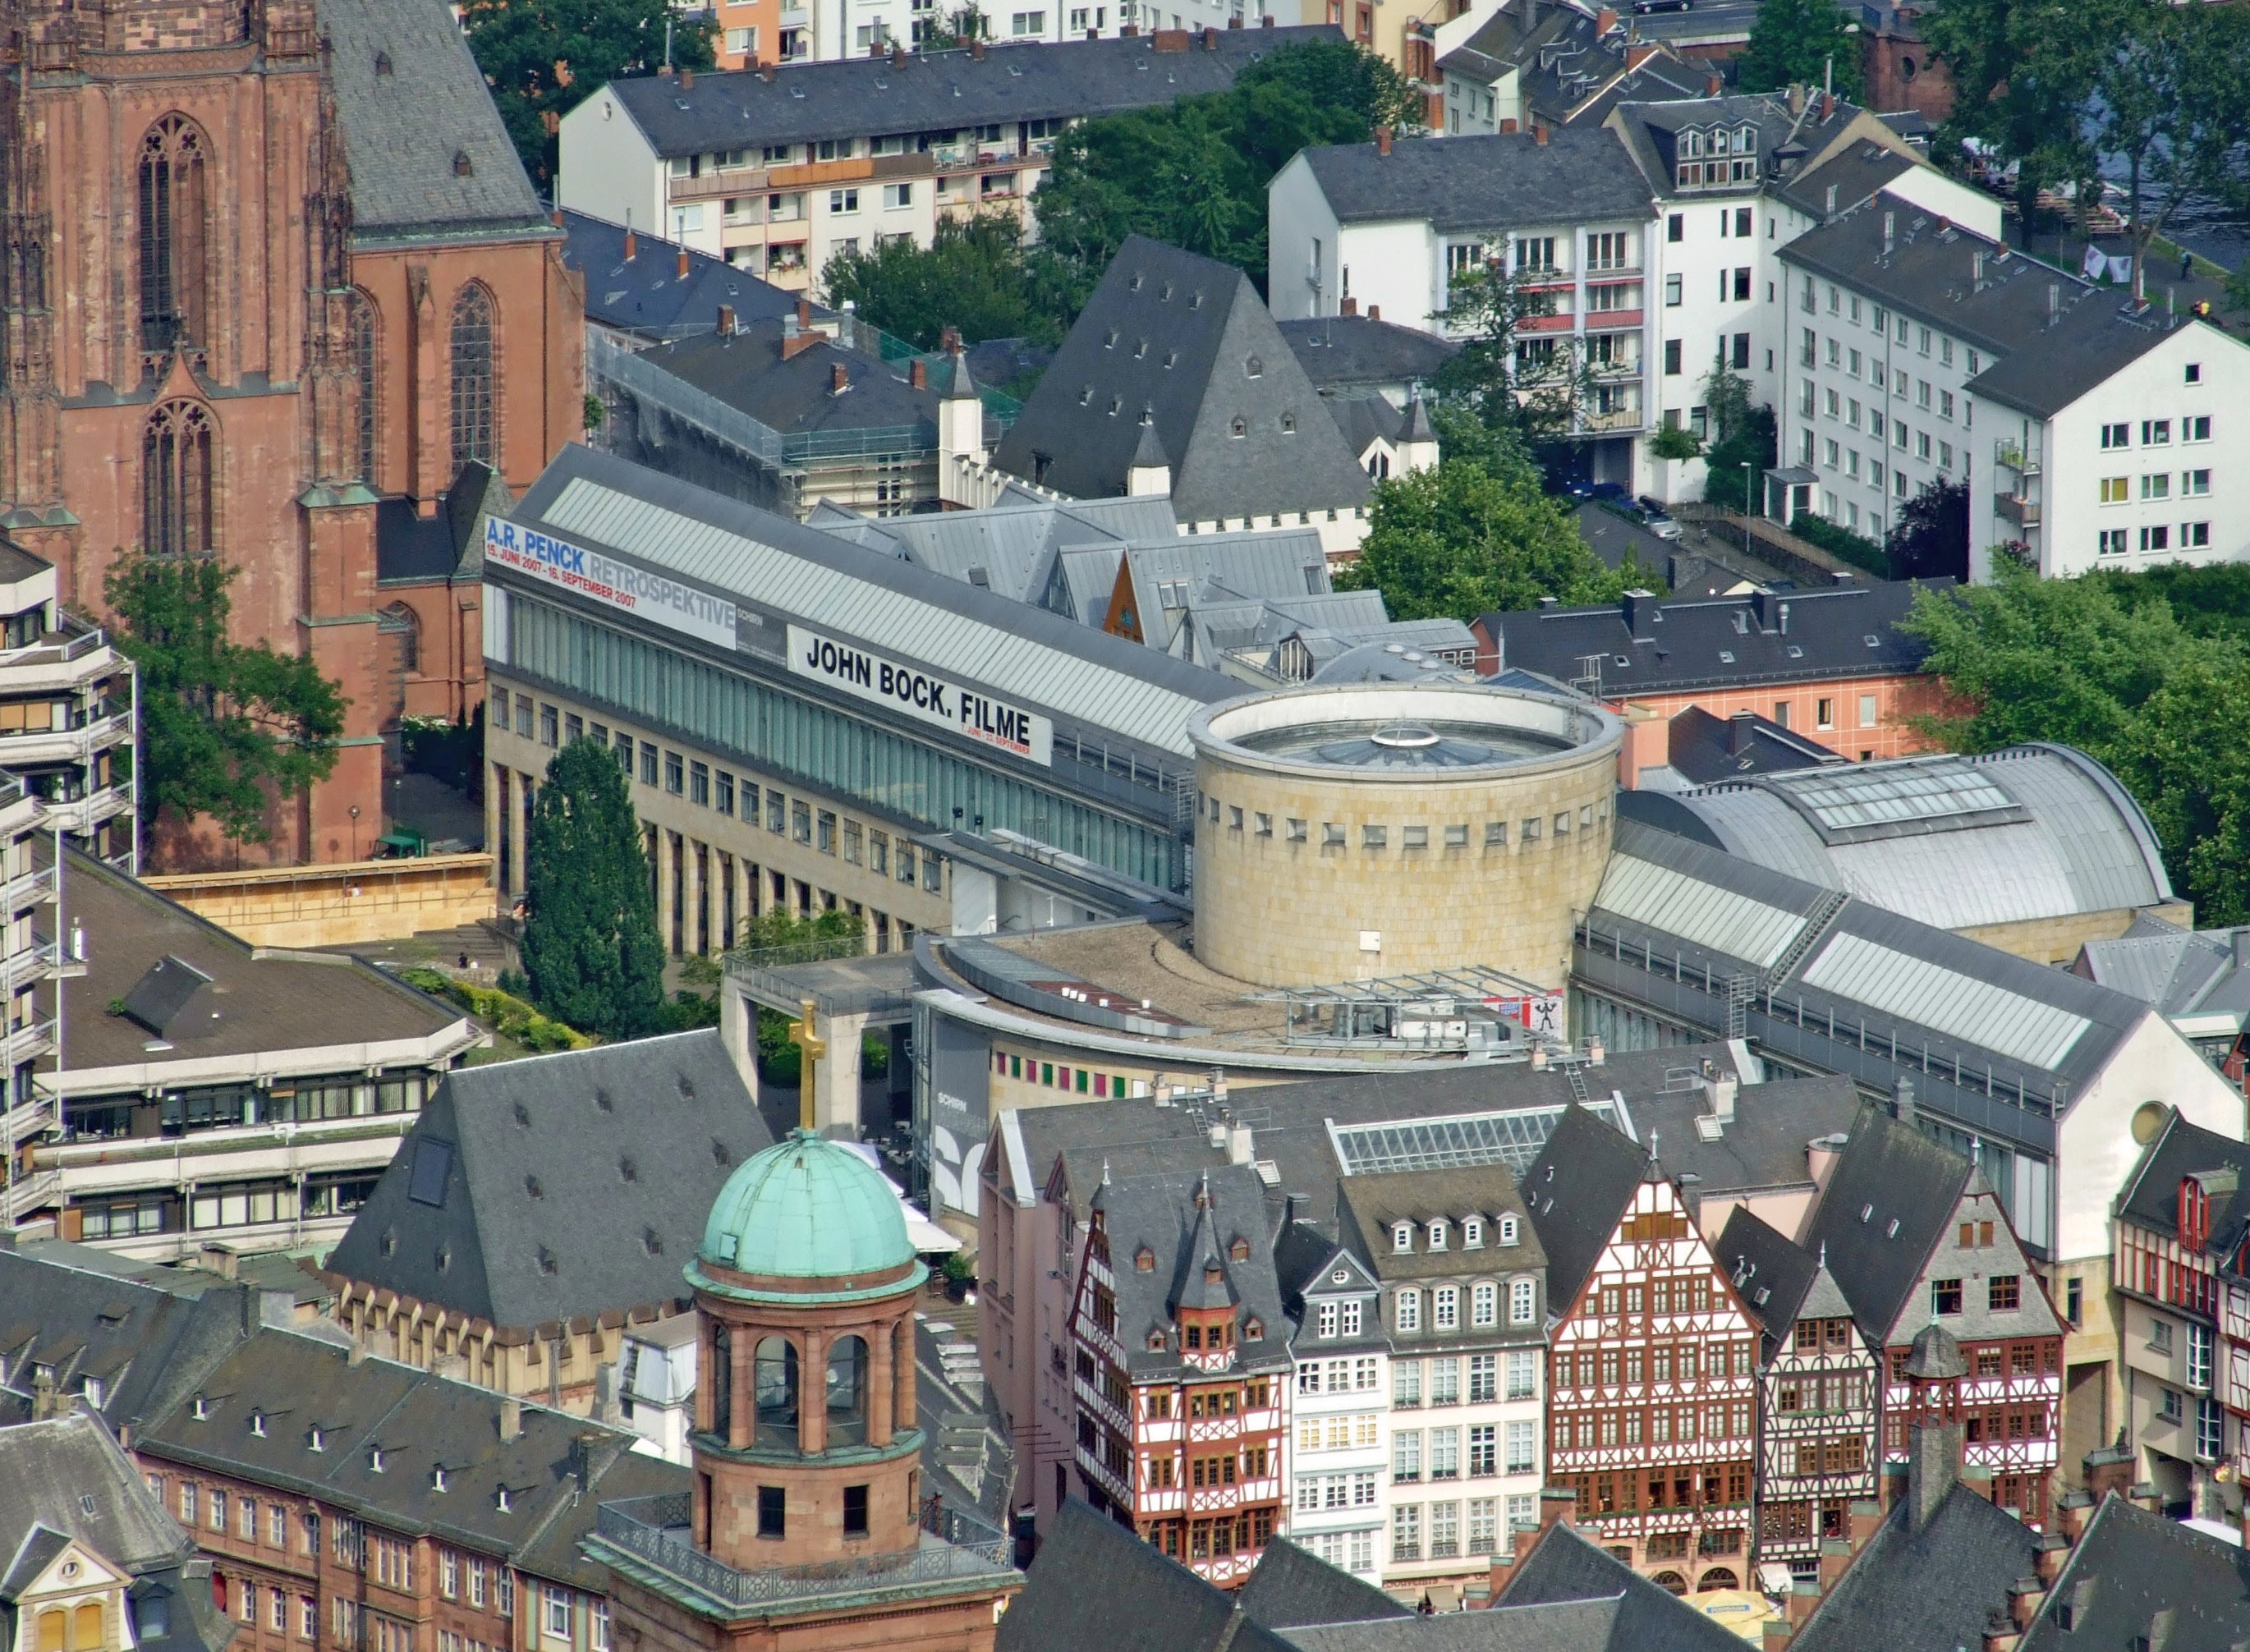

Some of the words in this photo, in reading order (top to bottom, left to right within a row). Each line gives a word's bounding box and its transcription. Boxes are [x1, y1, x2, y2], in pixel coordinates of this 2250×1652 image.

[486, 519, 519, 551] A.R.
[526, 531, 584, 575] PENCK
[590, 555, 736, 631] RETROSPEKTIVE
[488, 544, 497, 556] 15.
[500, 548, 519, 565] JUNI
[522, 557, 542, 573] 2007
[549, 567, 559, 580] 16.
[562, 571, 613, 599] SEPTEMBER
[616, 591, 636, 608] 2007
[807, 639, 870, 688] JOHN
[880, 663, 952, 718] BOCK.
[962, 692, 1030, 746] FILME
[967, 727, 981, 737] JUNI
[996, 737, 1030, 754] SEPTEMBER
[938, 1092, 967, 1113] SCHIRN
